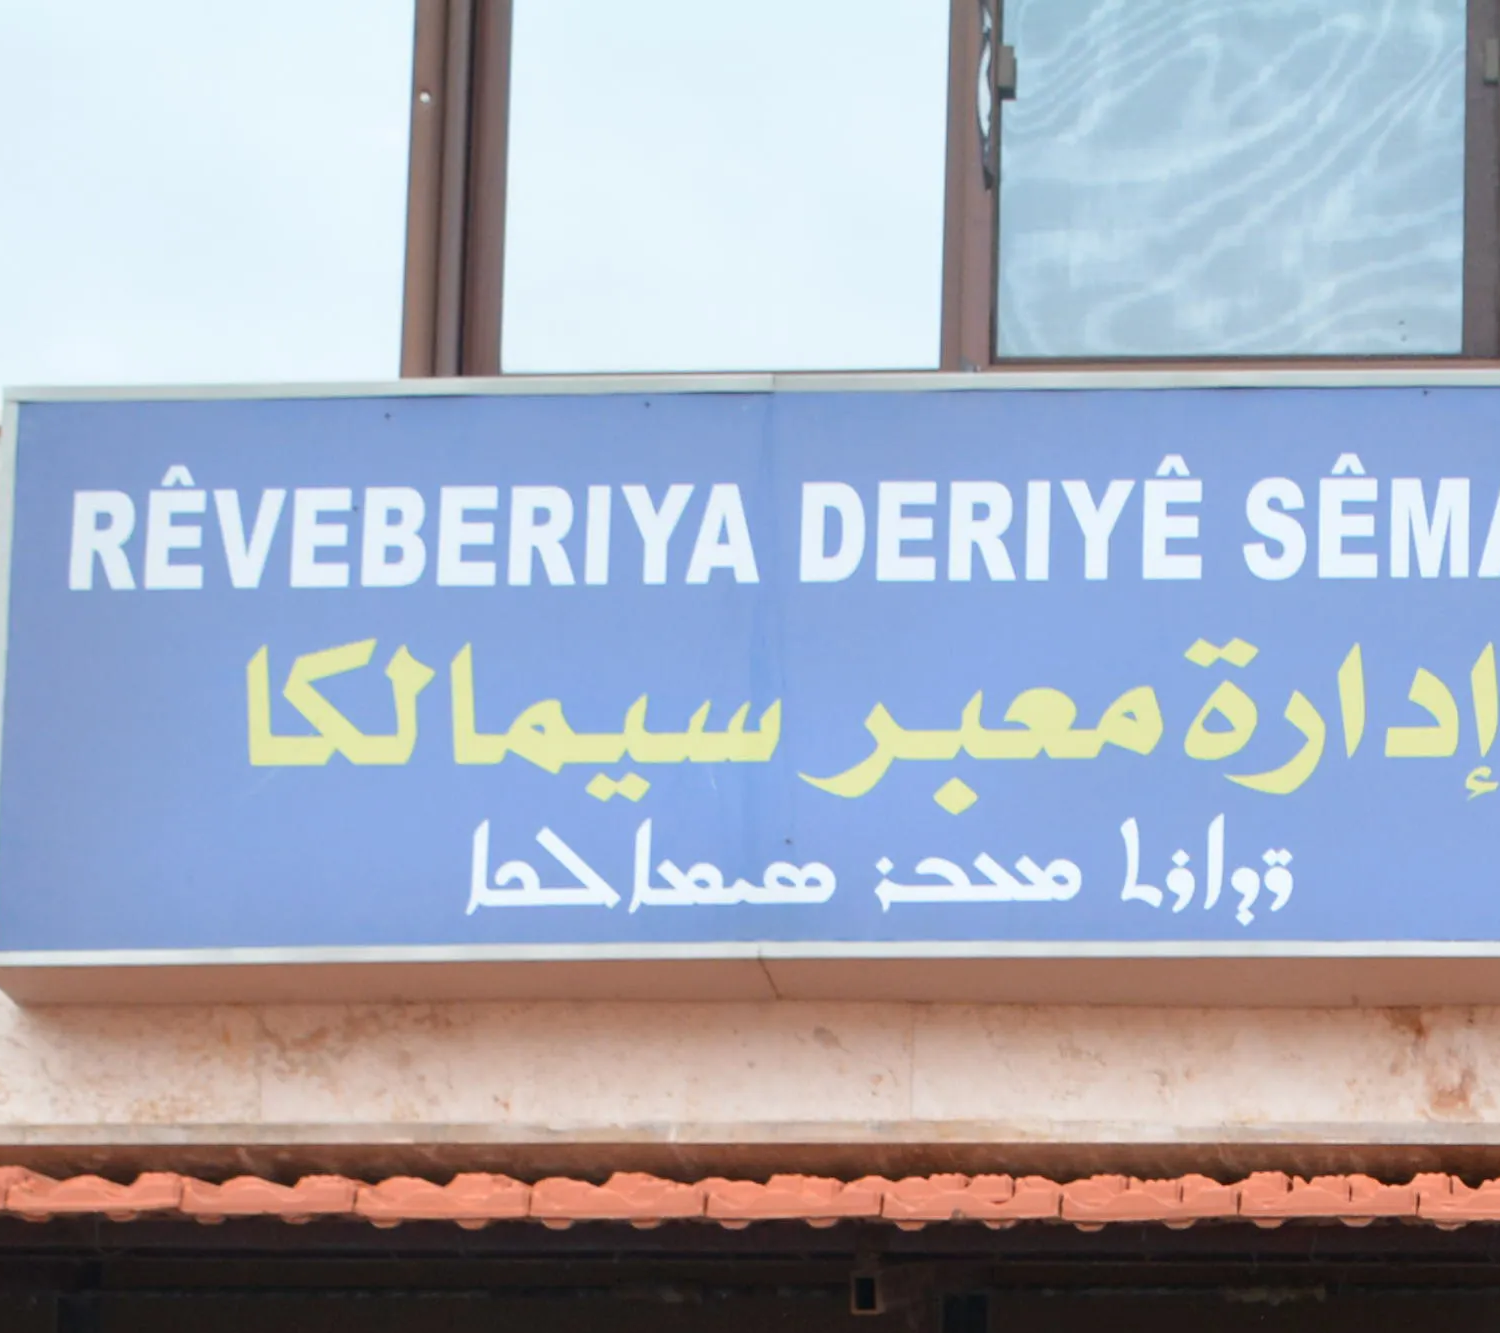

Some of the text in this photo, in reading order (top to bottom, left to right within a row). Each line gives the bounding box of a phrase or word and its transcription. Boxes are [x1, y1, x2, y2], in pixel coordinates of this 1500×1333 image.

[68, 464, 761, 591] RÊVEBERIYA
[798, 453, 1204, 583] DERIYÊ
[246, 636, 1500, 816] إدارة معبر سيمالكا
